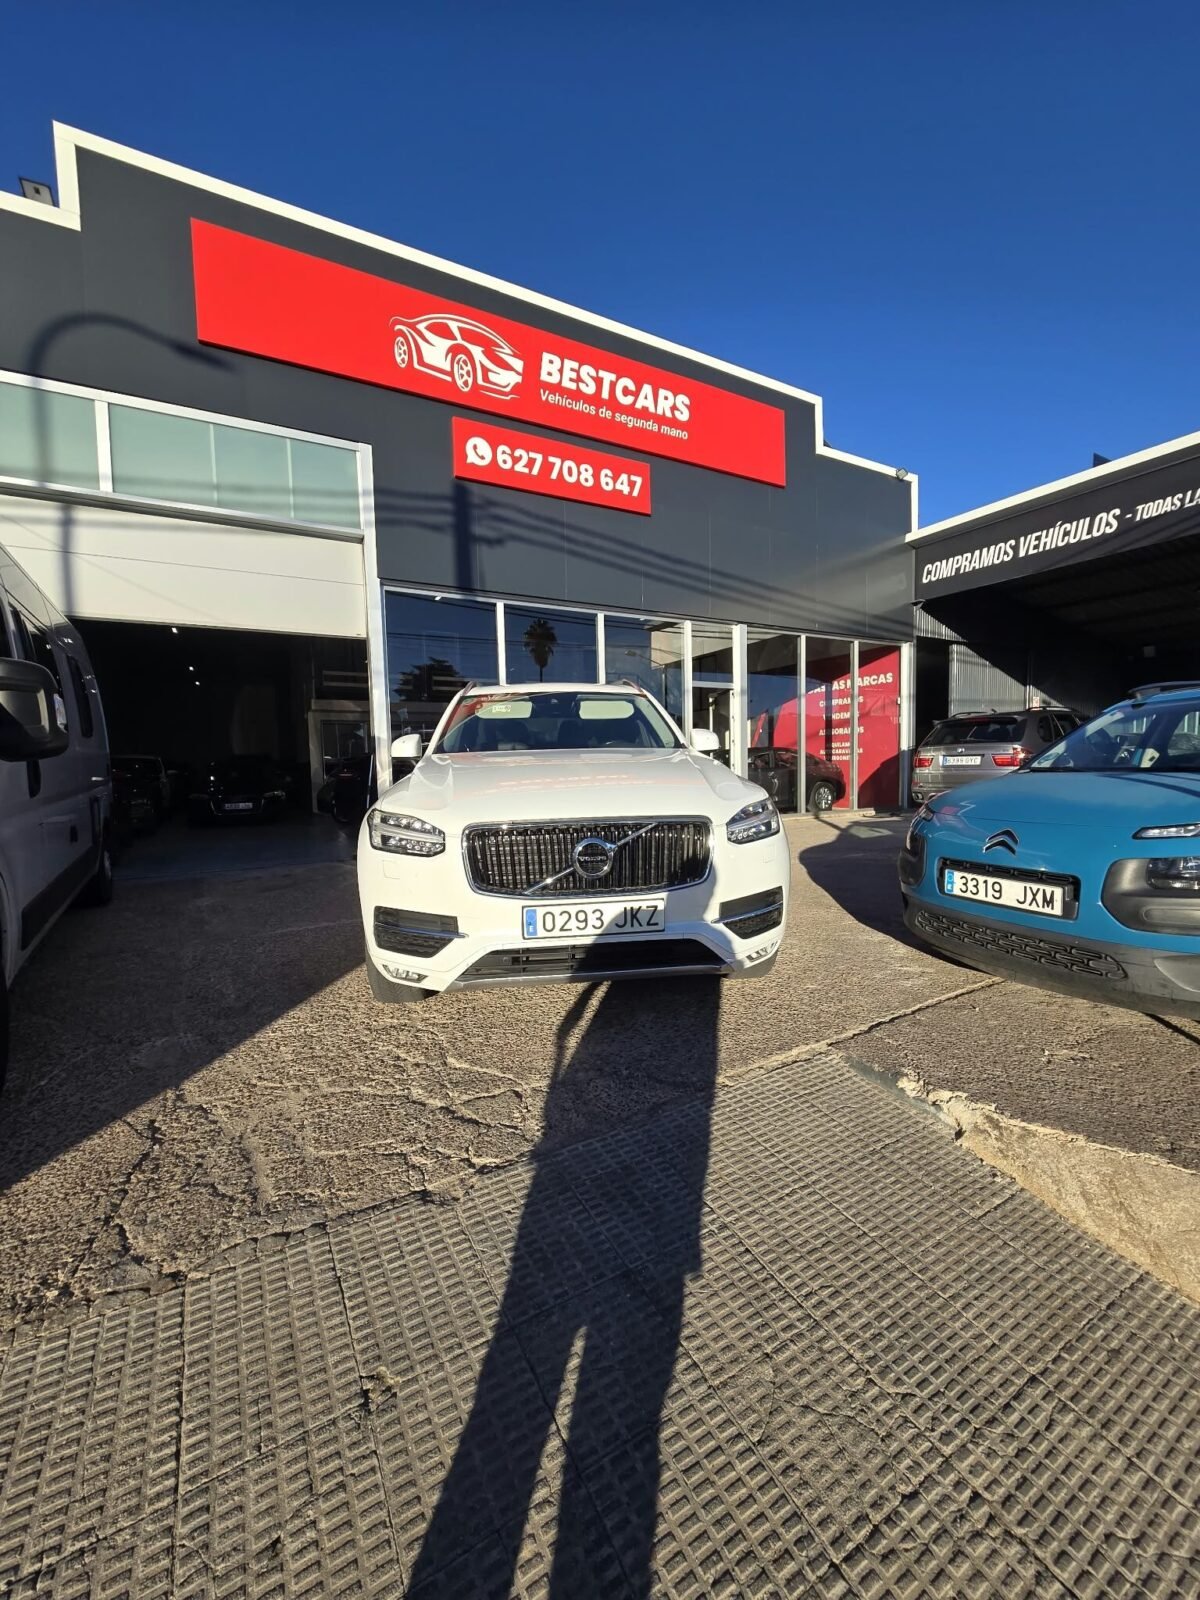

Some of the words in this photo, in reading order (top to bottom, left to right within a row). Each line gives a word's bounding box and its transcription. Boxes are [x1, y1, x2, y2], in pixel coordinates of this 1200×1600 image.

[540, 351, 691, 422] BESTCARS
[540, 388, 596, 416] Vehículos
[598, 404, 613, 419] de
[614, 411, 659, 433] segunda
[661, 427, 689, 440] mano
[496, 444, 543, 476] 627
[548, 455, 594, 488] 708
[599, 467, 643, 497] 647
[922, 539, 1016, 584] COMPRAMOS
[1018, 508, 1121, 558] VEHÍCULOS
[1135, 493, 1183, 522] TODAS
[542, 909, 605, 932] 0293
[614, 905, 659, 928] JKZ
[959, 875, 1002, 900] 3319
[1016, 885, 1055, 910] JXM
